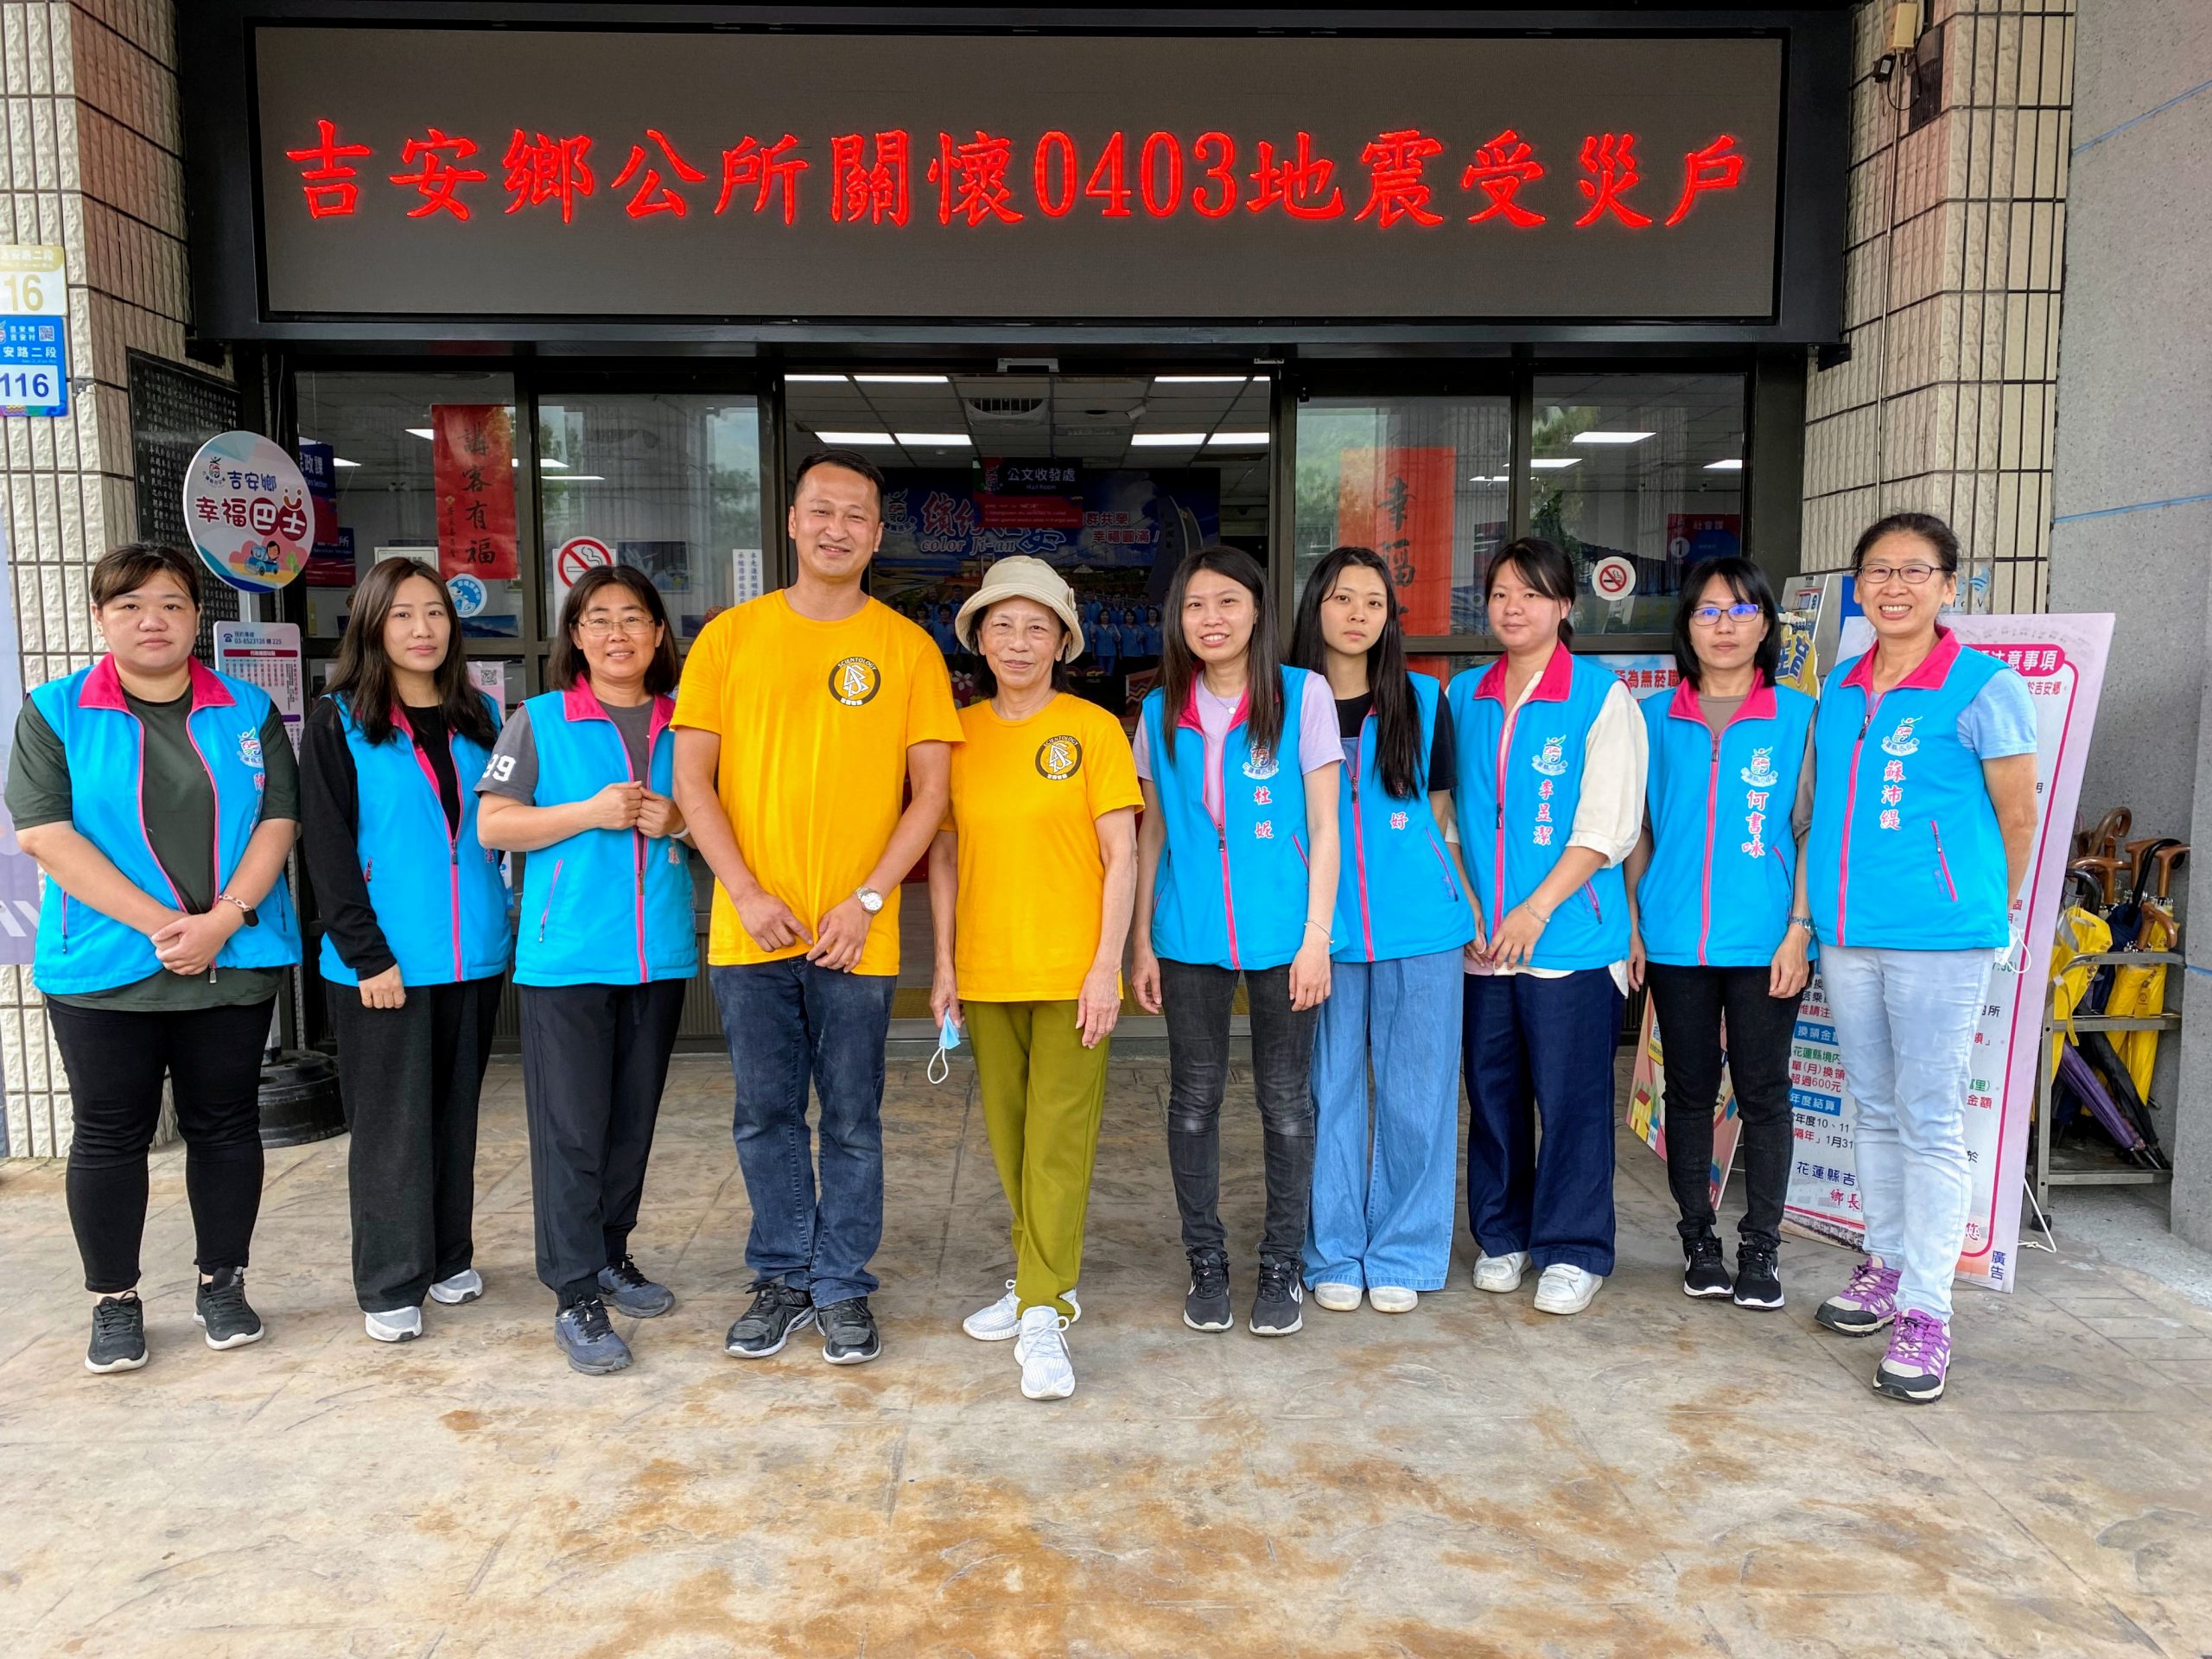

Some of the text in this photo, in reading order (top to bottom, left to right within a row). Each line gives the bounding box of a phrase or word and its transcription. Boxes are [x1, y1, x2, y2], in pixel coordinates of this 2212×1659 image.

[286, 120, 1744, 229] 吉安鄉公所關懷0403地震受災戶
[227, 470, 276, 492] 吉安鄉
[1007, 467, 1076, 482] 公文收發處
[457, 422, 496, 566] 講客有福
[196, 495, 306, 535] 幸福巴士
[1378, 476, 1418, 637] 幸福
[837, 657, 877, 671] SCIENTOLOGY
[1789, 1092, 1836, 1112] 年度結算
[1967, 1094, 1993, 1110] 金額
[1796, 1160, 1859, 1186] 花蓮縣吉
[1991, 1250, 2006, 1281] 廣告
